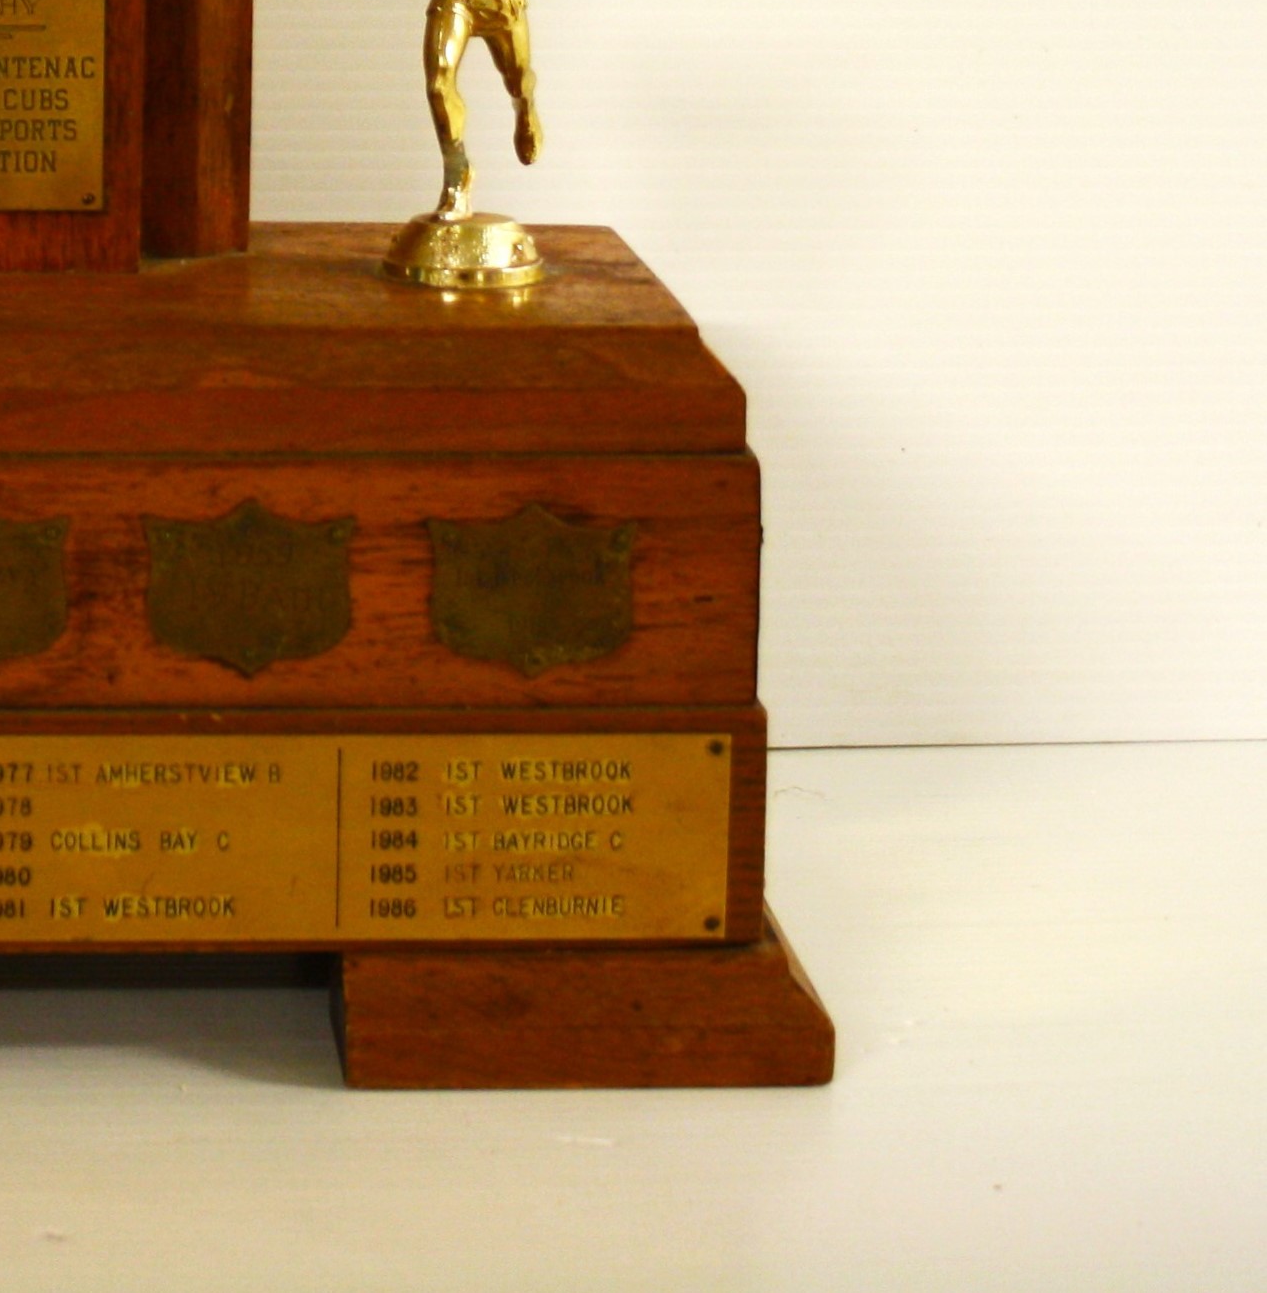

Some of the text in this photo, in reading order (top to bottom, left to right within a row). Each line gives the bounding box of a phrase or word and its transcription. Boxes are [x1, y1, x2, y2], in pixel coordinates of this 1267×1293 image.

[3, 88, 69, 110] CUBS
[95, 764, 255, 785] AMHERSTVIEW
[372, 762, 420, 782] 1982
[501, 761, 631, 780] WESTBROOK
[370, 797, 418, 816] 1983
[502, 794, 633, 815] WESTBROOK
[50, 832, 140, 851] COLLINS
[160, 832, 198, 850] BAY
[217, 832, 229, 849] C
[370, 830, 418, 849] 1984
[493, 831, 595, 850] BAYRIDGE
[610, 831, 623, 849] C
[370, 865, 417, 884] 1985
[494, 865, 575, 883] YARKER
[104, 898, 236, 918] WESTBROOK
[370, 899, 416, 918] 1986
